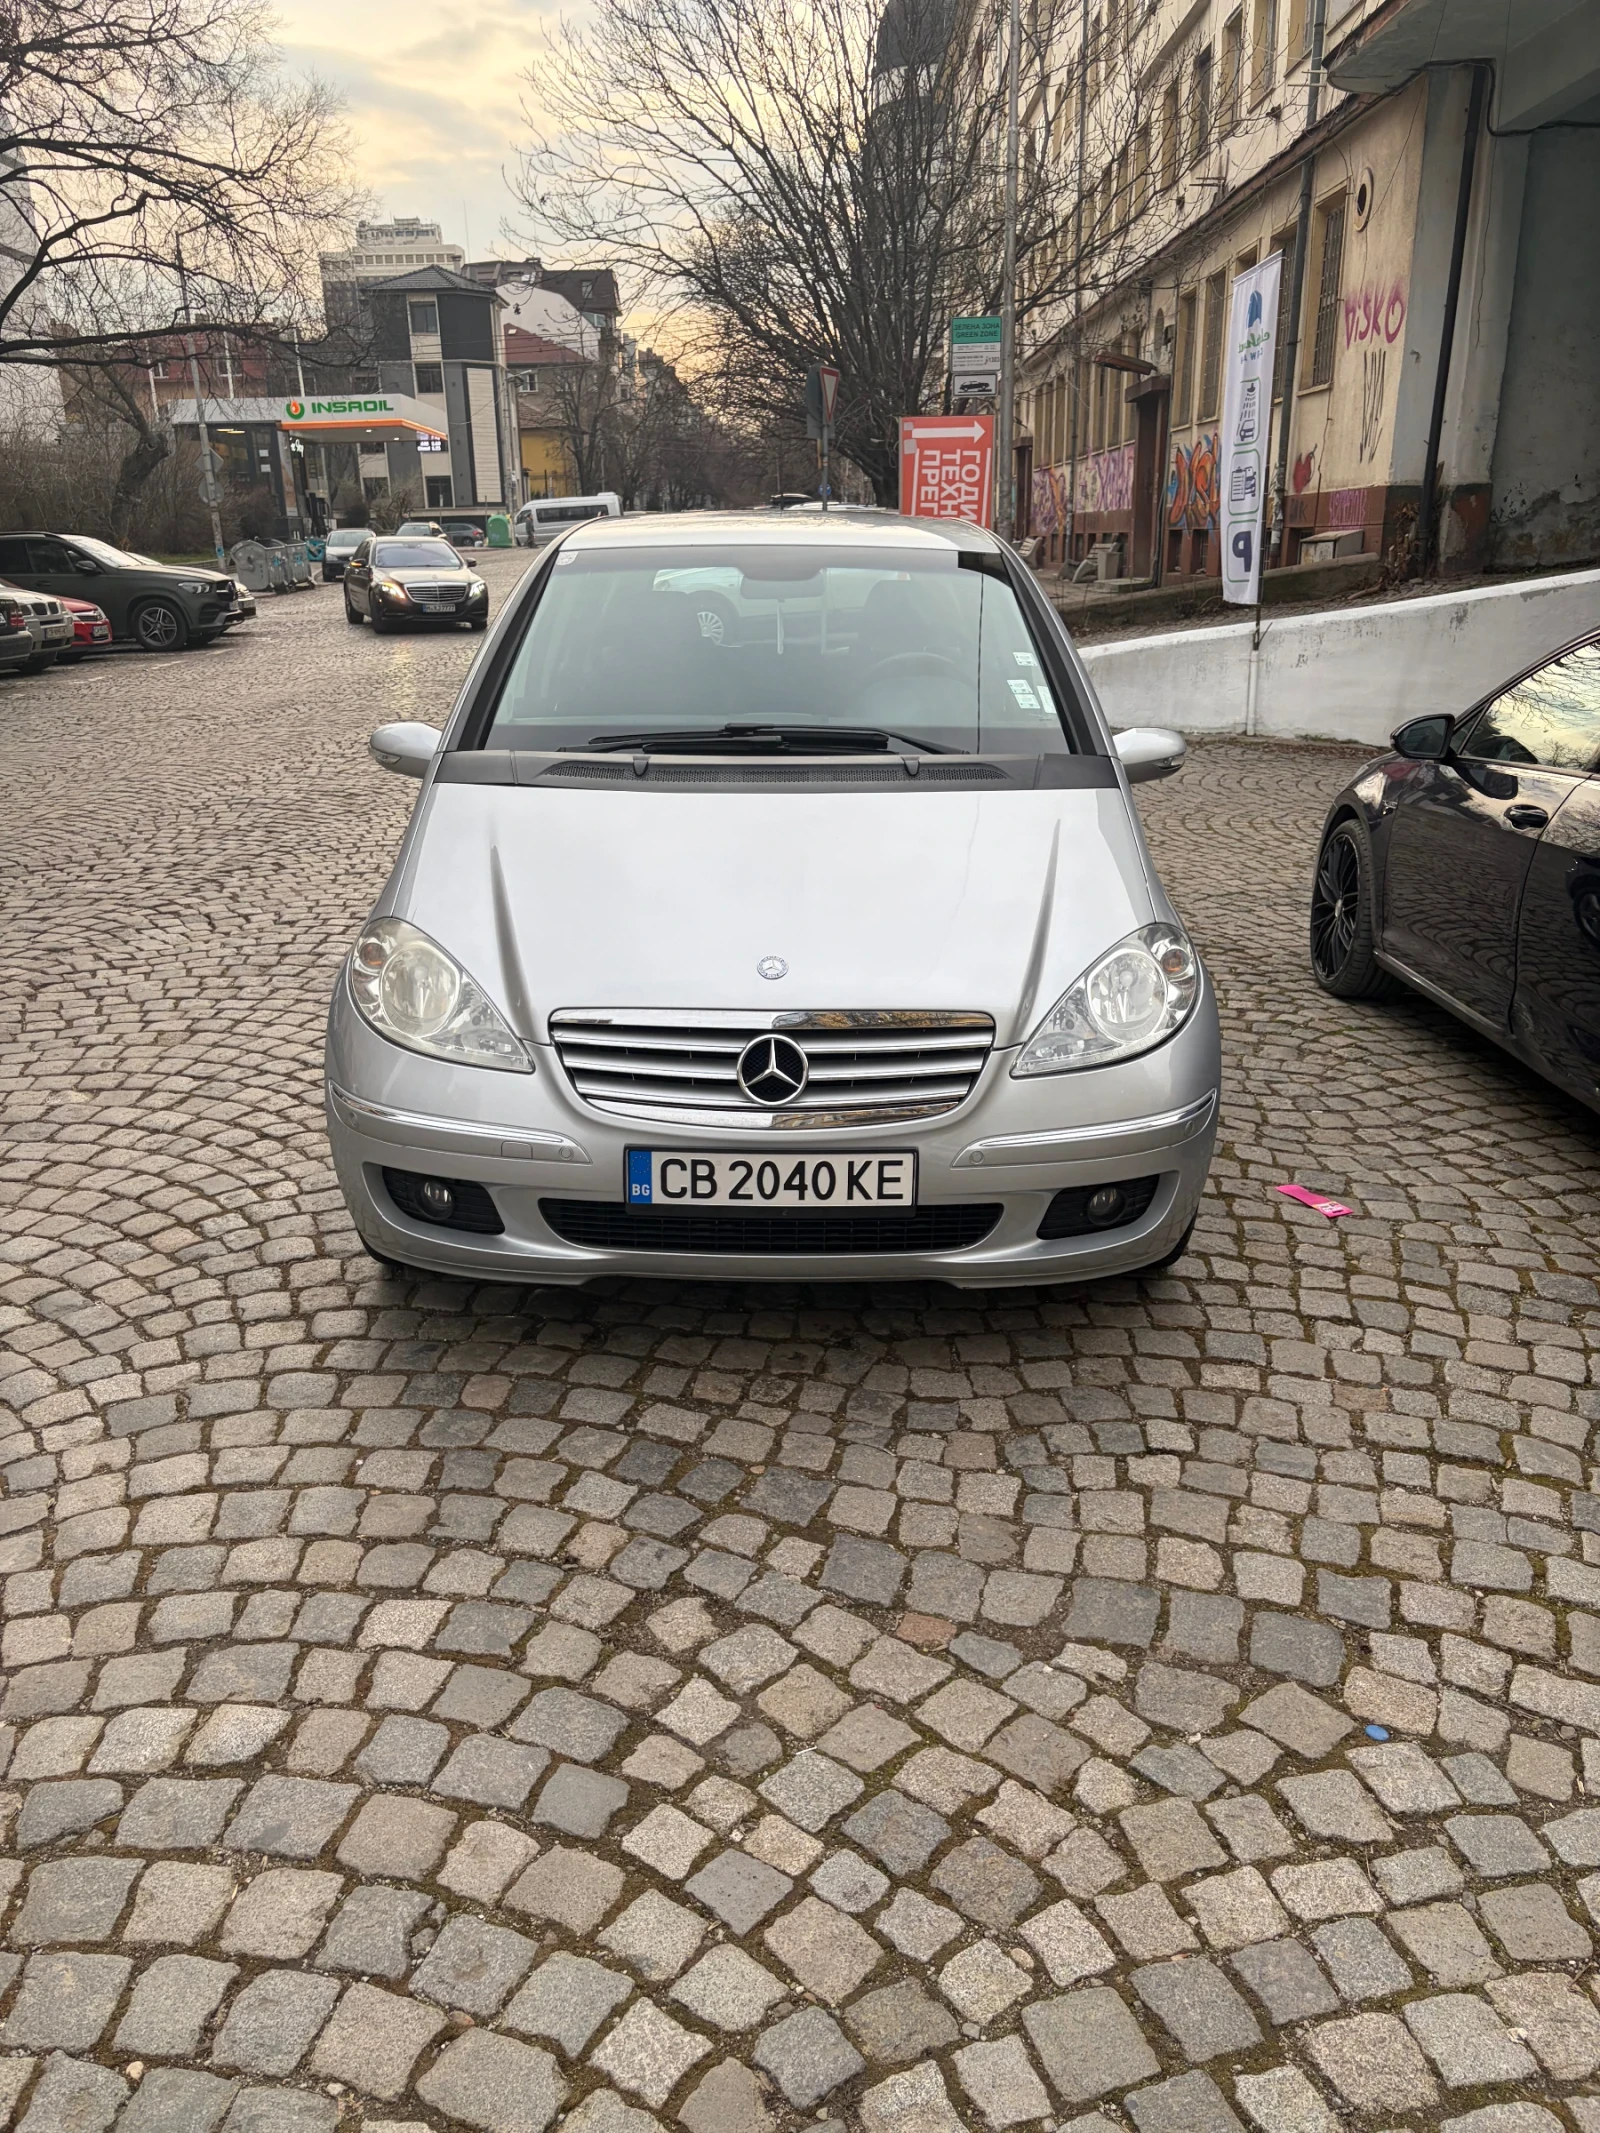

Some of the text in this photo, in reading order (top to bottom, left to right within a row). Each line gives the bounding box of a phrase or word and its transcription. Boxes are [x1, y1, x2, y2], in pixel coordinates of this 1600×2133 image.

[312, 400, 394, 413] INSAOIL
[660, 1158, 904, 1200] CB 2040 KE
[632, 1184, 650, 1196] BG
